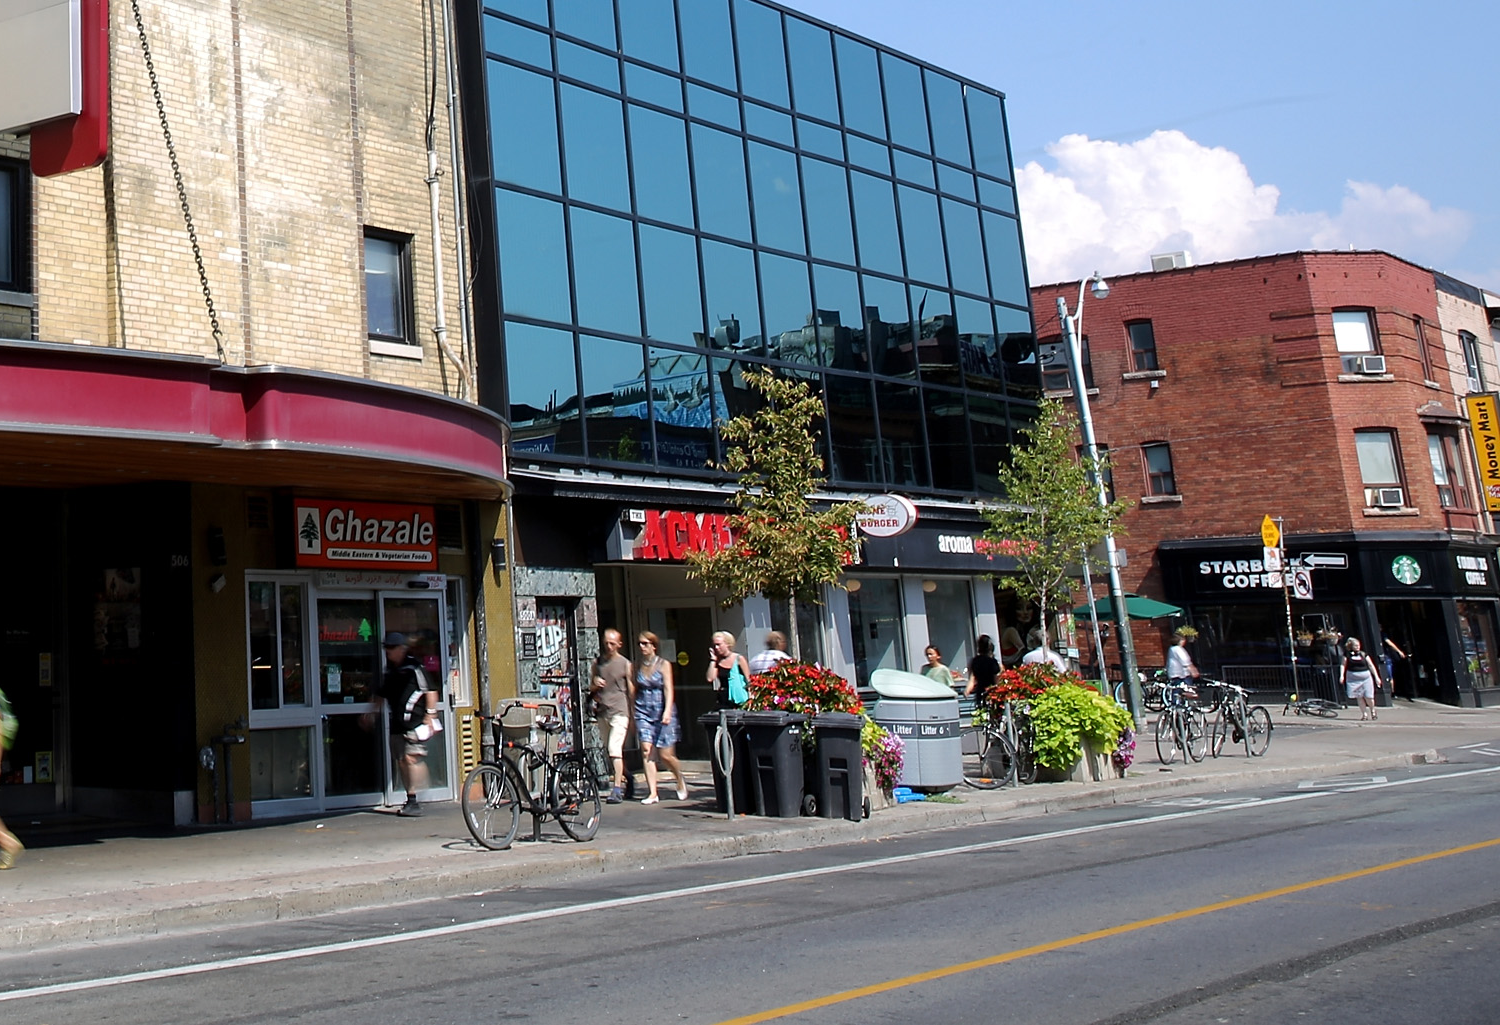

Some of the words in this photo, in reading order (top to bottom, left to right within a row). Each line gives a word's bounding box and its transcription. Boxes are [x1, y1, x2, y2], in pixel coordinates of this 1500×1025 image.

[1475, 402, 1490, 432] Mart
[1483, 435, 1500, 479] Money
[325, 508, 434, 545] Ghazale
[860, 519, 898, 527] BURGER
[938, 534, 974, 554] aroma
[171, 554, 190, 567] 506
[332, 550, 350, 558] Middle
[352, 551, 374, 559] Eastern
[381, 552, 411, 561] Vegetarian
[893, 725, 913, 735] Litter
[921, 725, 937, 735] Litter
